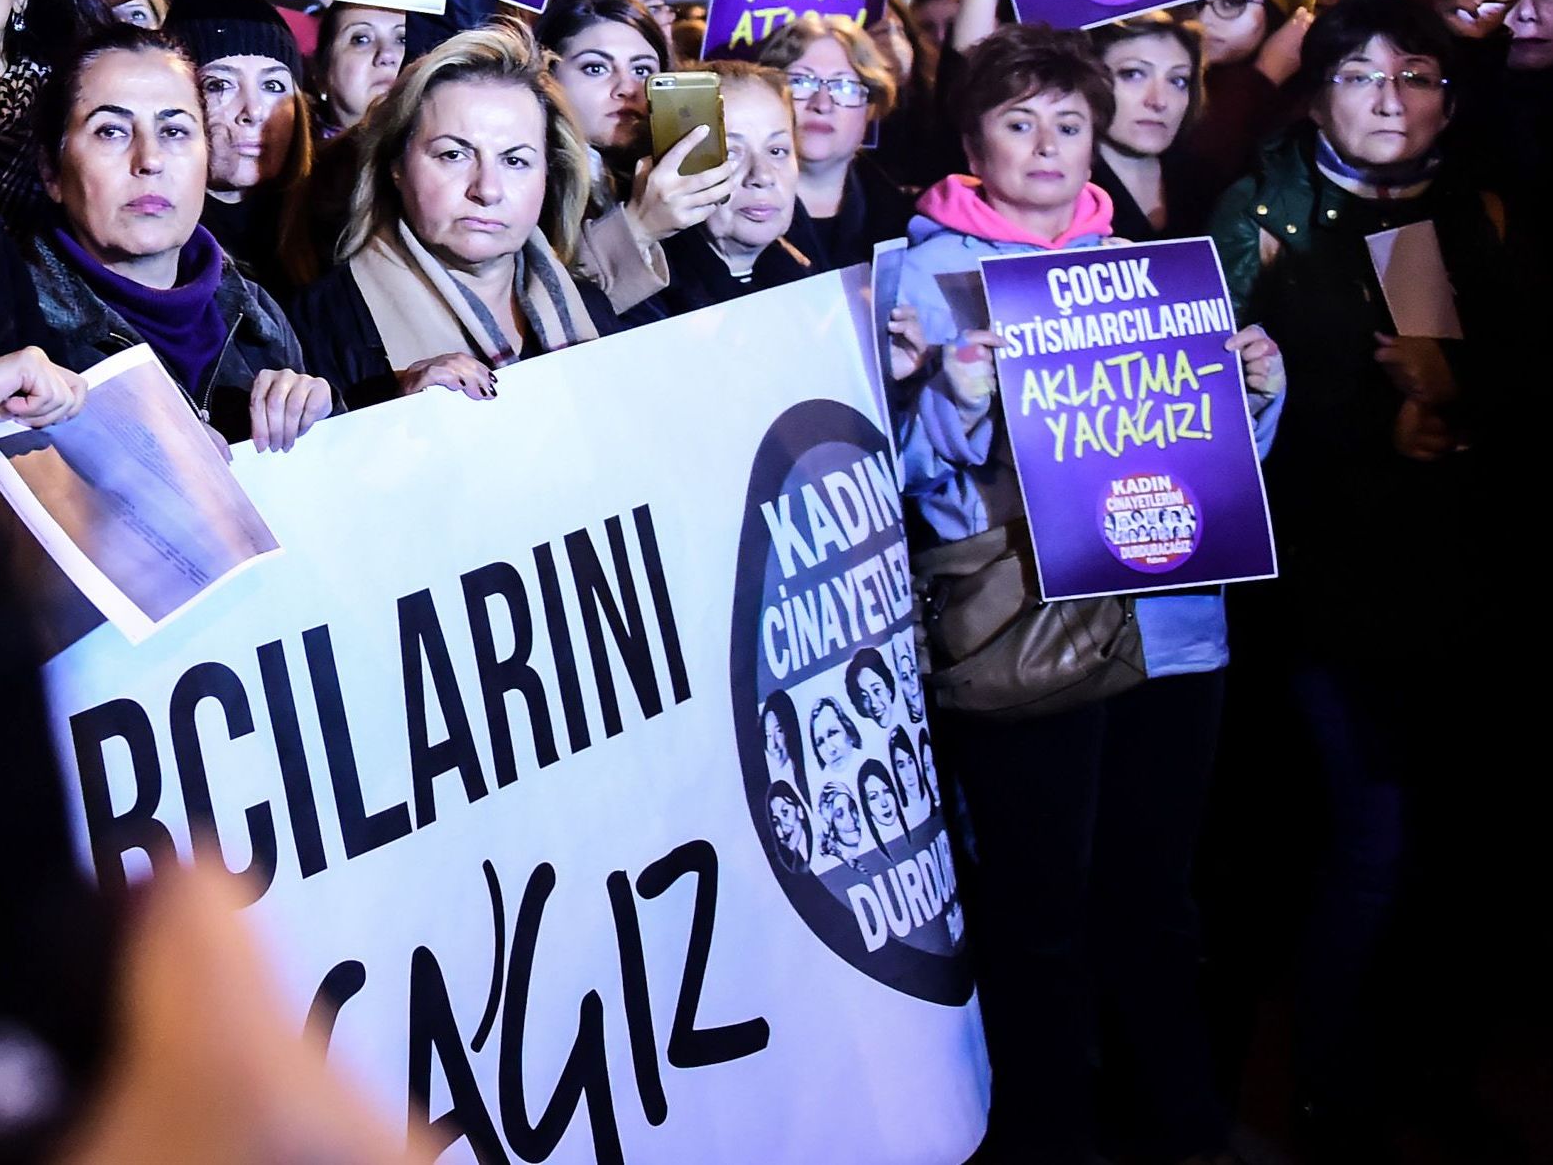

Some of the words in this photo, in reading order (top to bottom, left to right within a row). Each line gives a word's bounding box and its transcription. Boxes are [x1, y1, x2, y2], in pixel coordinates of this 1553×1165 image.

[1046, 257, 1159, 314] ÇOCUK
[1021, 349, 1225, 416] AKLATMA-
[760, 450, 904, 580] KADIN
[1111, 475, 1173, 496] KADIN
